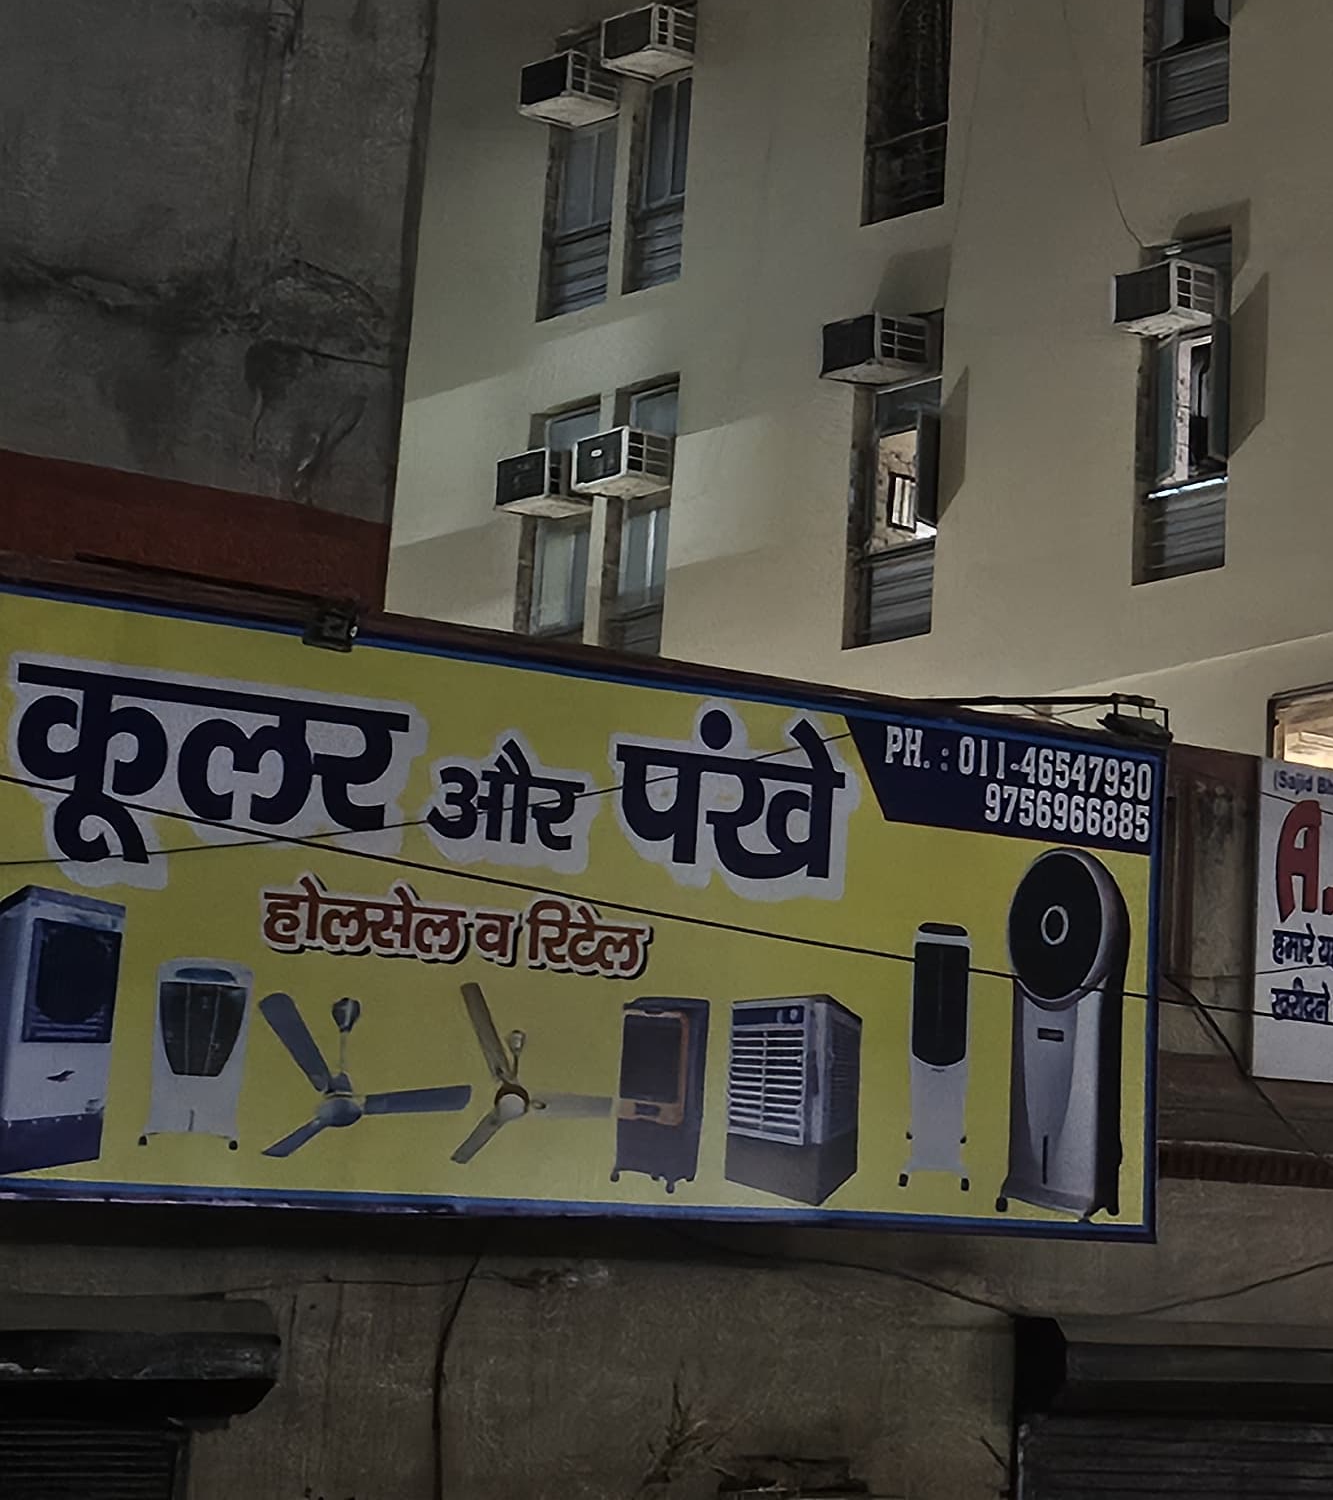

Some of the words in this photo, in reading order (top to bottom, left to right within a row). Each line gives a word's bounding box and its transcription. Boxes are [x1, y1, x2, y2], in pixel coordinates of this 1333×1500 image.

[17, 663, 410, 864] कूलर
[426, 738, 585, 851] और
[616, 709, 846, 879] पंखे
[884, 725, 931, 768] PH.
[958, 736, 1152, 801] 011-46547930
[984, 783, 1150, 842] 9756966885
[263, 875, 467, 954] होलसेल
[475, 912, 515, 958] व
[527, 900, 646, 970] रिटेल
